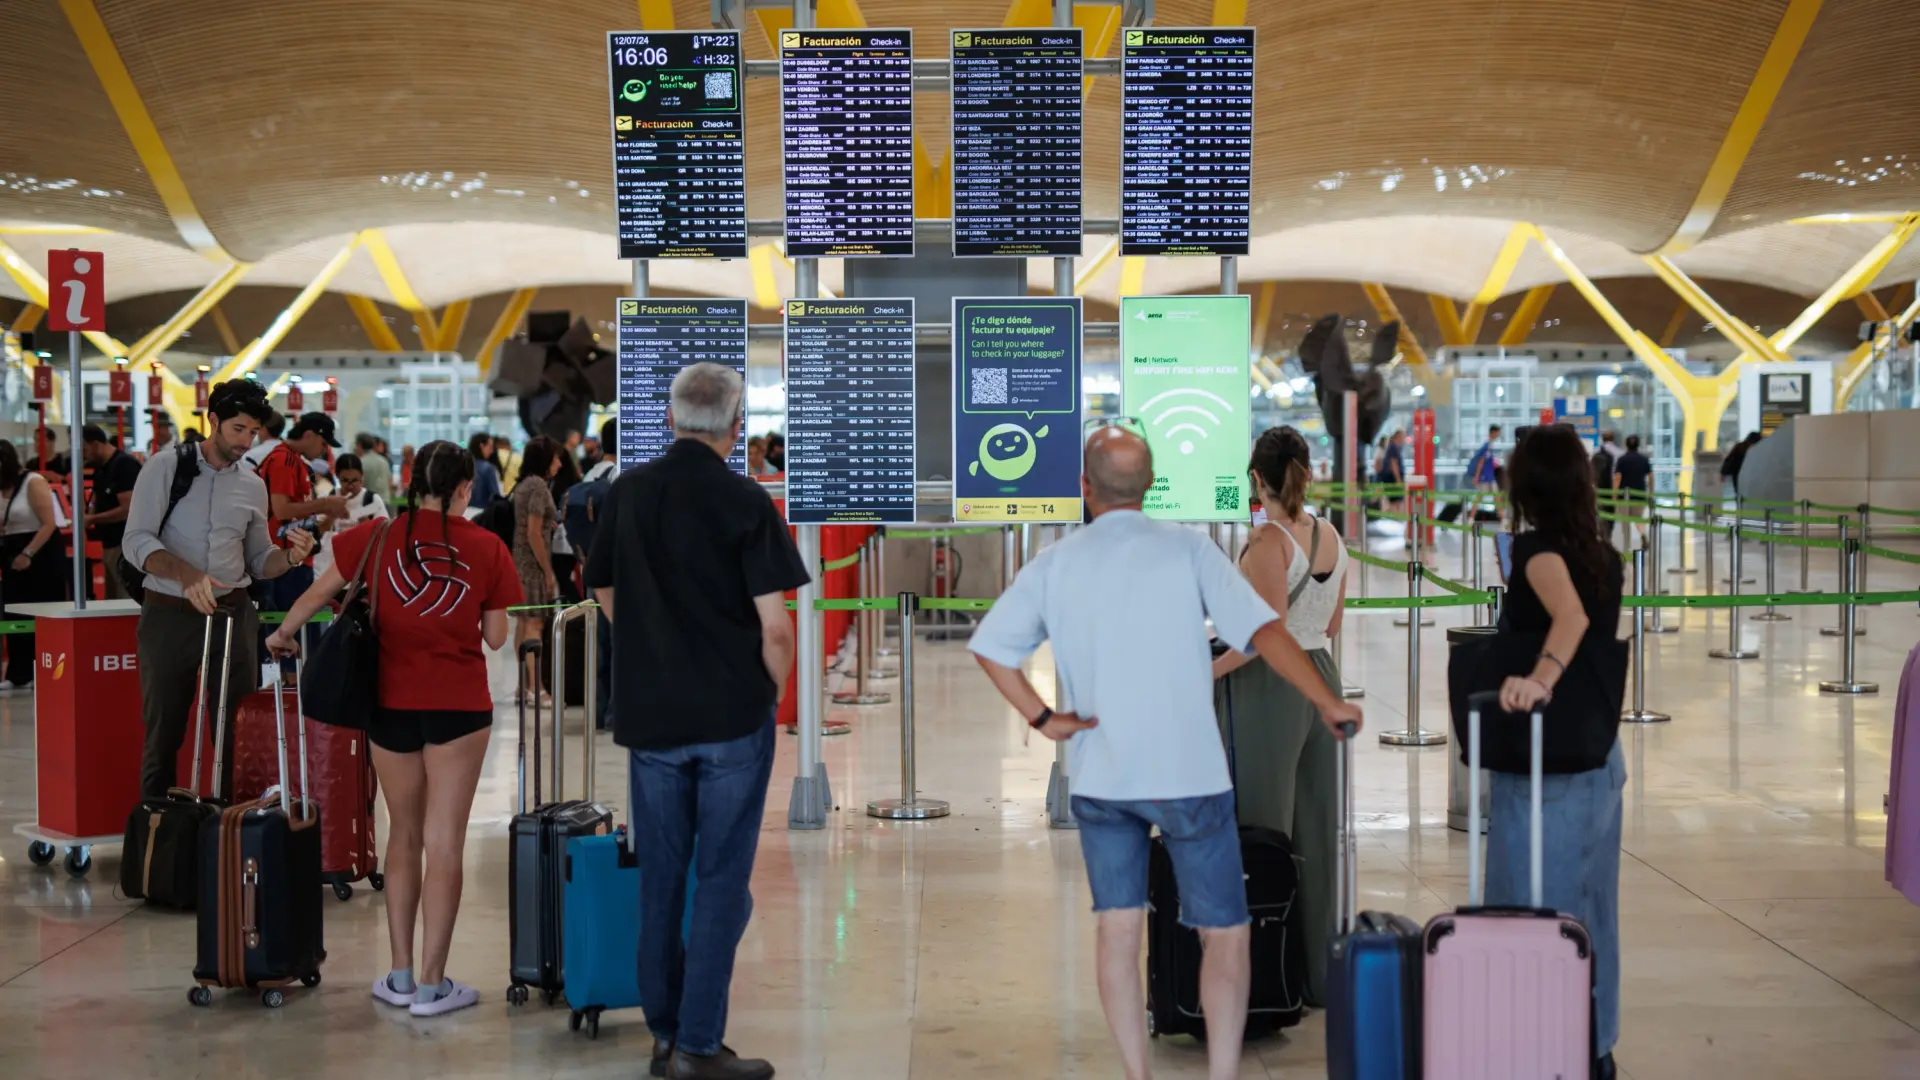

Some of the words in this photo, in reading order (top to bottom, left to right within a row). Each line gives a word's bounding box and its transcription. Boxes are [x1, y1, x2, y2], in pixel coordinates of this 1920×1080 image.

[614, 36, 649, 44] 12/07/24
[803, 37, 861, 46] Facturación
[975, 36, 1032, 45] Facturación
[1147, 35, 1205, 44] Facturación
[615, 48, 667, 65] 16:06
[704, 55, 729, 64] H:32
[636, 120, 693, 128] Facturación
[641, 305, 698, 314] Facturación
[808, 305, 864, 314] Facturación
[972, 317, 985, 326] ¿Te
[988, 317, 1005, 325] digo
[1016, 326, 1055, 335] equipaje?
[1032, 350, 1065, 359] luggage?
[1134, 367, 1170, 375] AIRPORT
[40, 376, 48, 389] 6
[116, 381, 125, 393] 7
[1041, 504, 1054, 513] T4
[42, 652, 52, 668] IB
[94, 654, 136, 671] IBE
